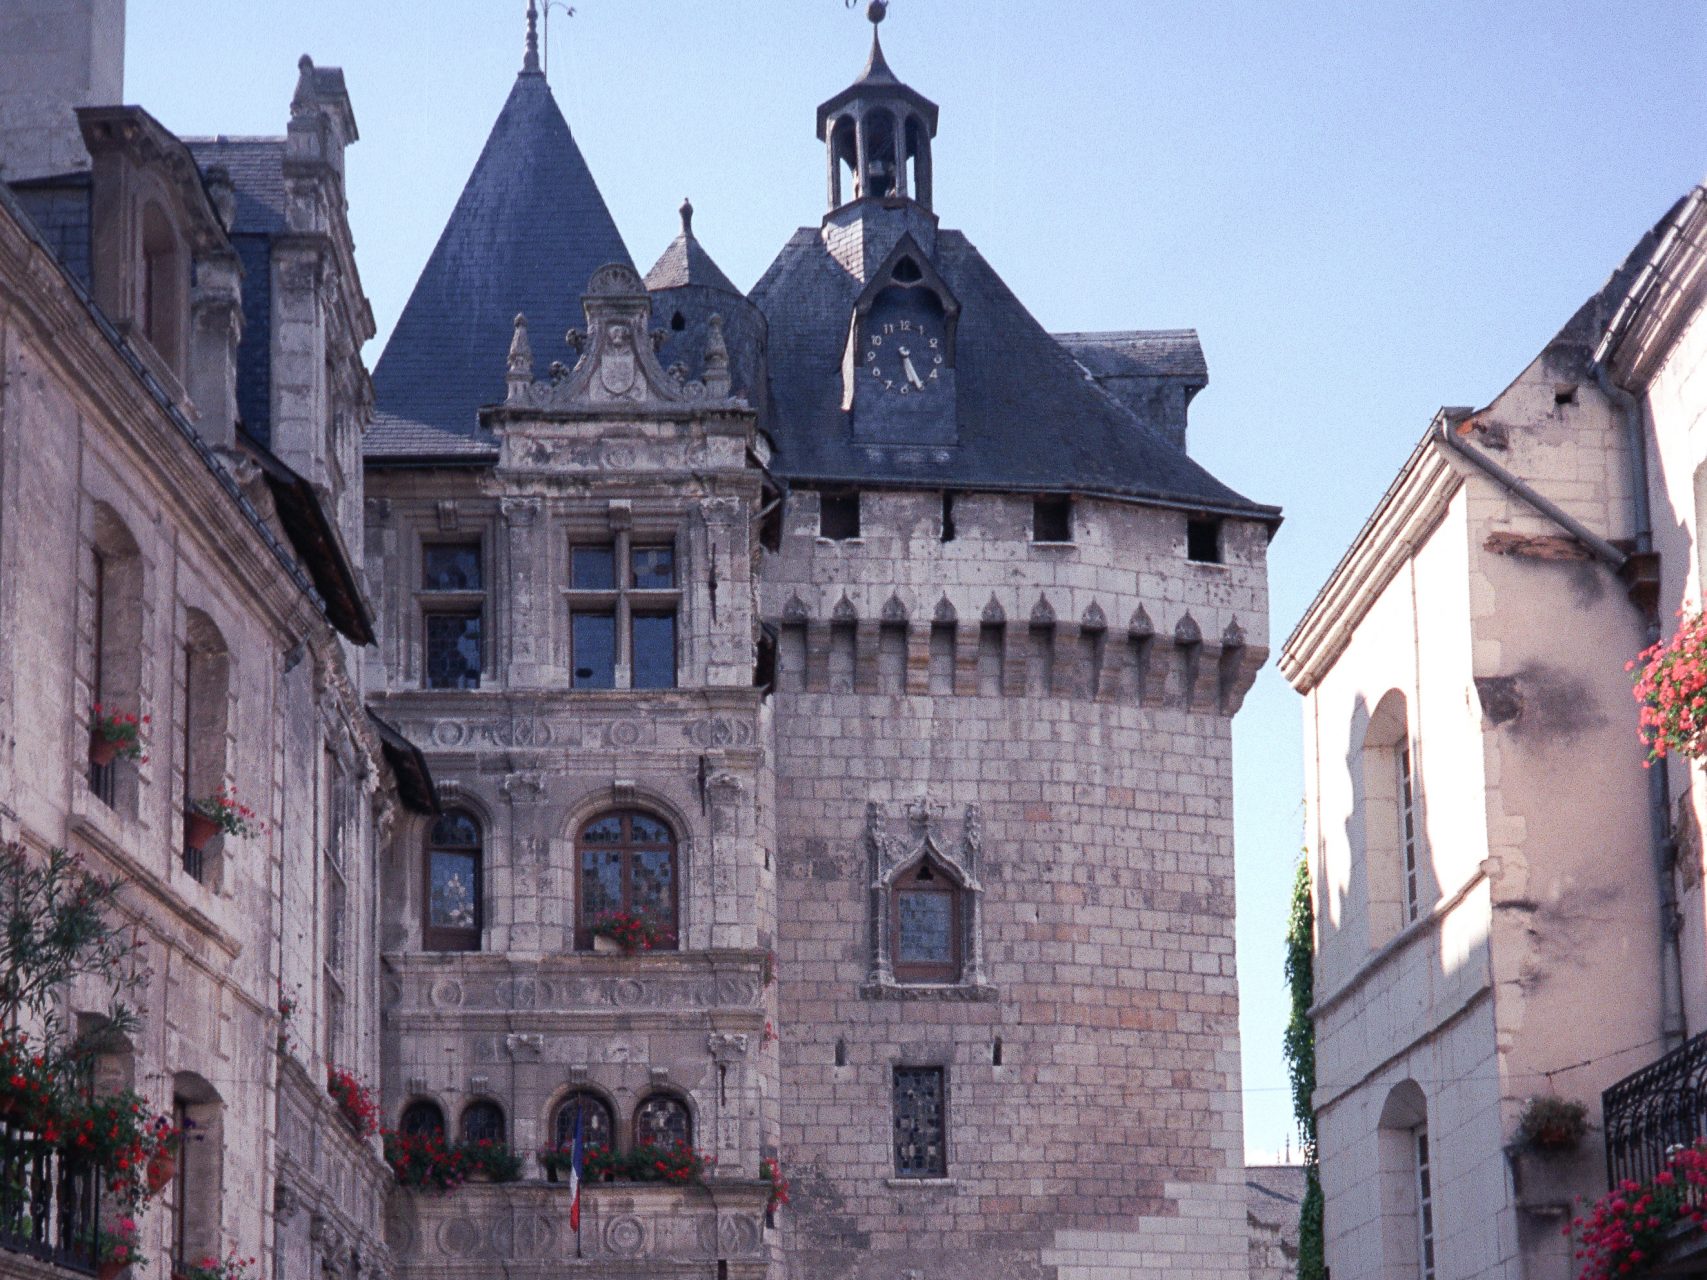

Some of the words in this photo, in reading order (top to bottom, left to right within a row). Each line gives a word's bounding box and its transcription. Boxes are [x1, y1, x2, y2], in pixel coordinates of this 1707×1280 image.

[884, 323, 894, 335] 11
[899, 319, 911, 331] 12
[919, 324, 924, 335] 1
[871, 335, 882, 347] 10
[929, 338, 938, 348] 2
[867, 351, 876, 362] 9
[929, 368, 938, 379] 4
[885, 380, 892, 391] 7
[900, 382, 909, 394] 6
